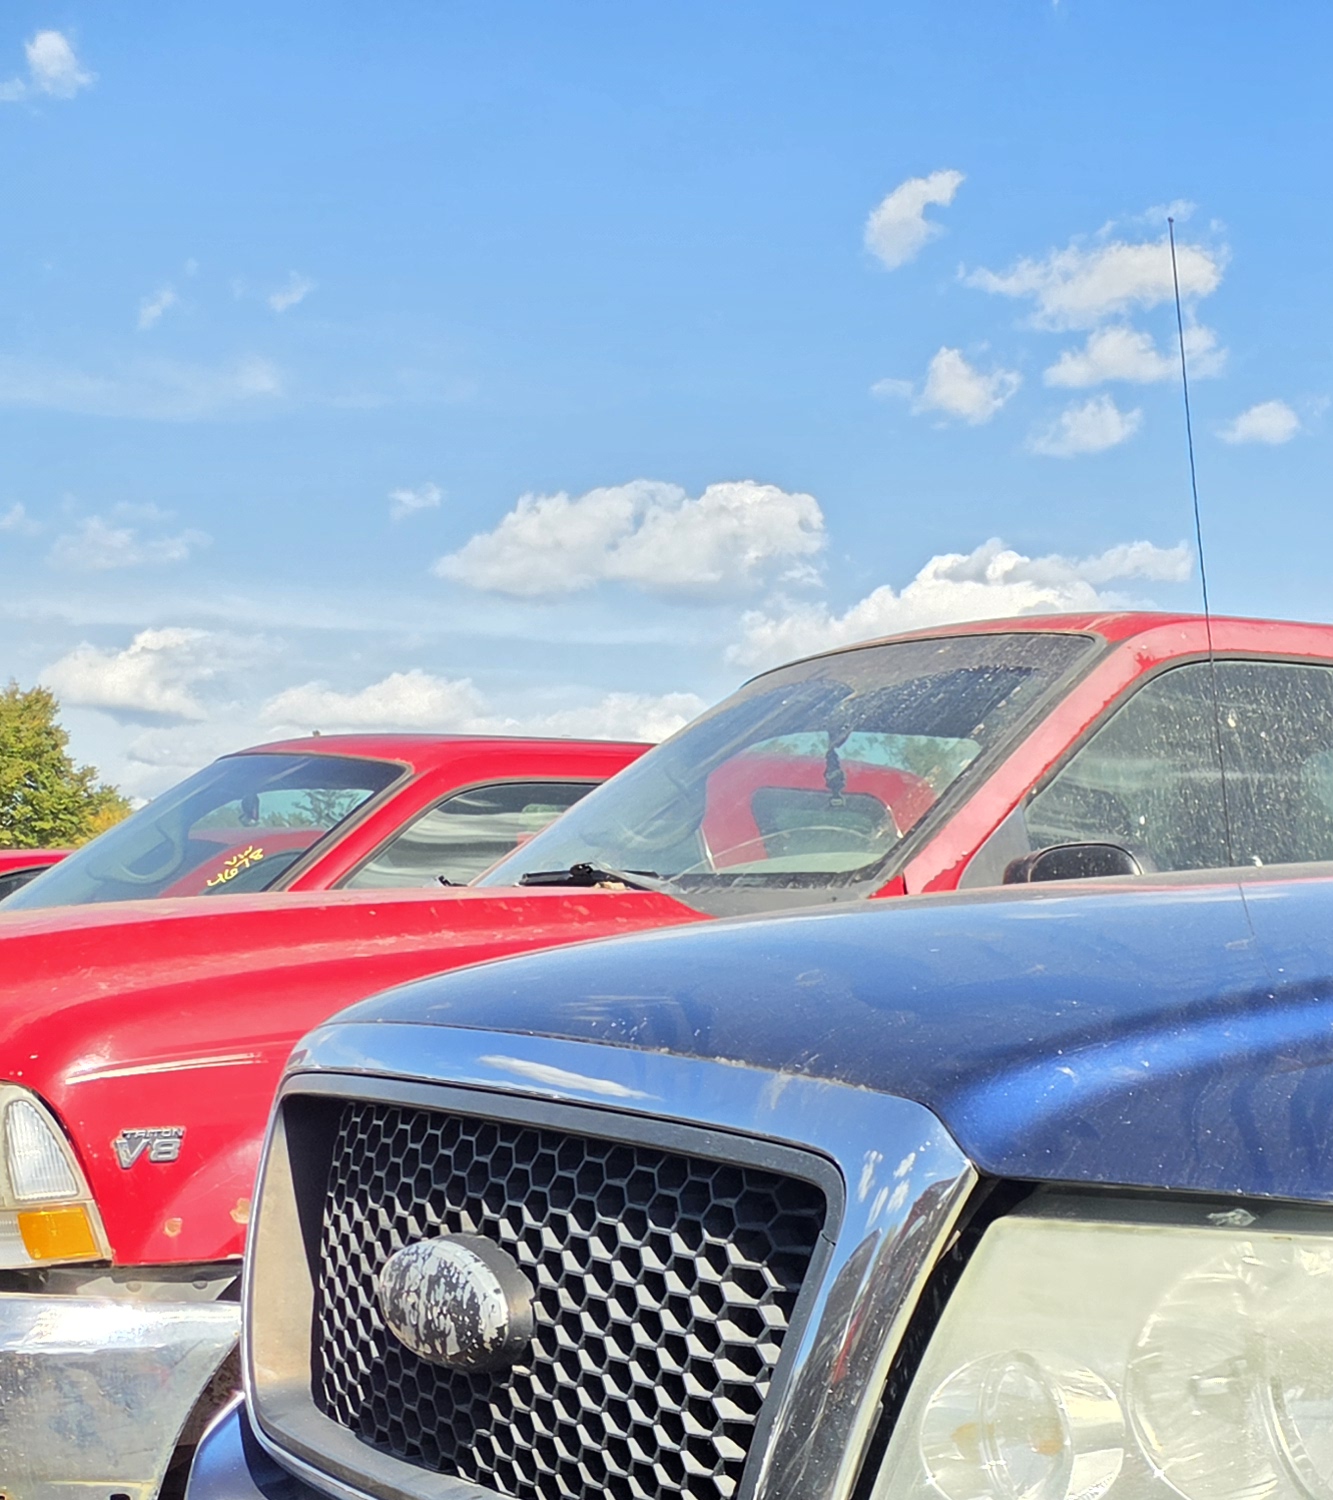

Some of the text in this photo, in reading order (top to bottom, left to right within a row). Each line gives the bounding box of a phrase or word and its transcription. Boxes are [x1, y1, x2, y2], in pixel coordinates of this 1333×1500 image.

[206, 848, 264, 887] 4678
[121, 1127, 186, 1139] TRITON
[115, 1138, 182, 1169] V8
